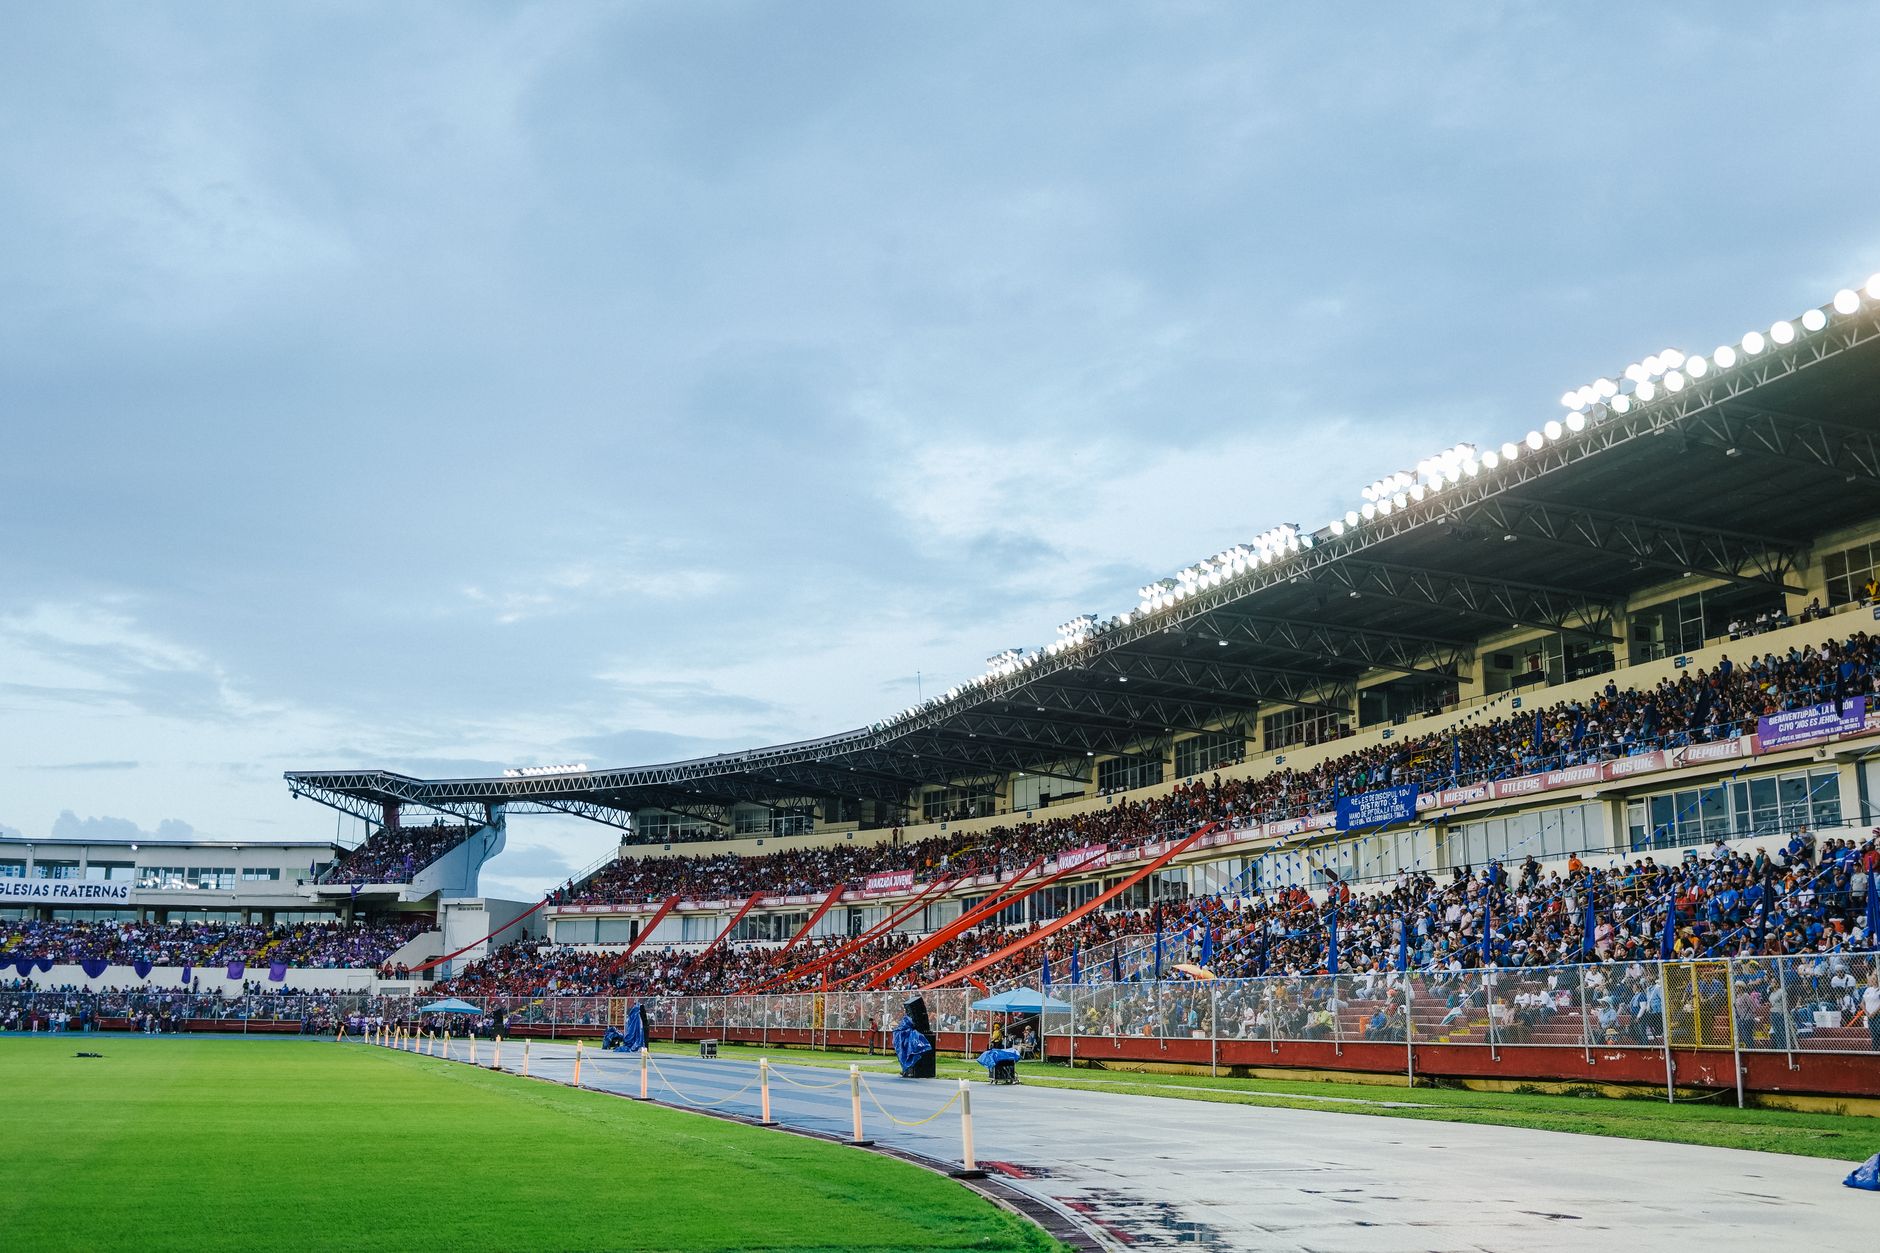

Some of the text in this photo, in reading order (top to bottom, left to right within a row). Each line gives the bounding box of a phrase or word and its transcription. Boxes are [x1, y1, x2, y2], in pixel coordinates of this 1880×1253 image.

[1821, 706, 1829, 714] LA
[1830, 699, 1854, 713] NIÓN
[1809, 718, 1818, 726] ES
[1688, 741, 1738, 760] DEPORTE
[1612, 762, 1632, 775] NOS
[1547, 767, 1596, 785] IMPORTAN
[1501, 778, 1540, 794] ATLETAS
[1444, 787, 1485, 803] NUESTROS
[1270, 825, 1276, 834] EL
[1307, 818, 1315, 828] ES
[53, 885, 127, 898] FRATERNAS
